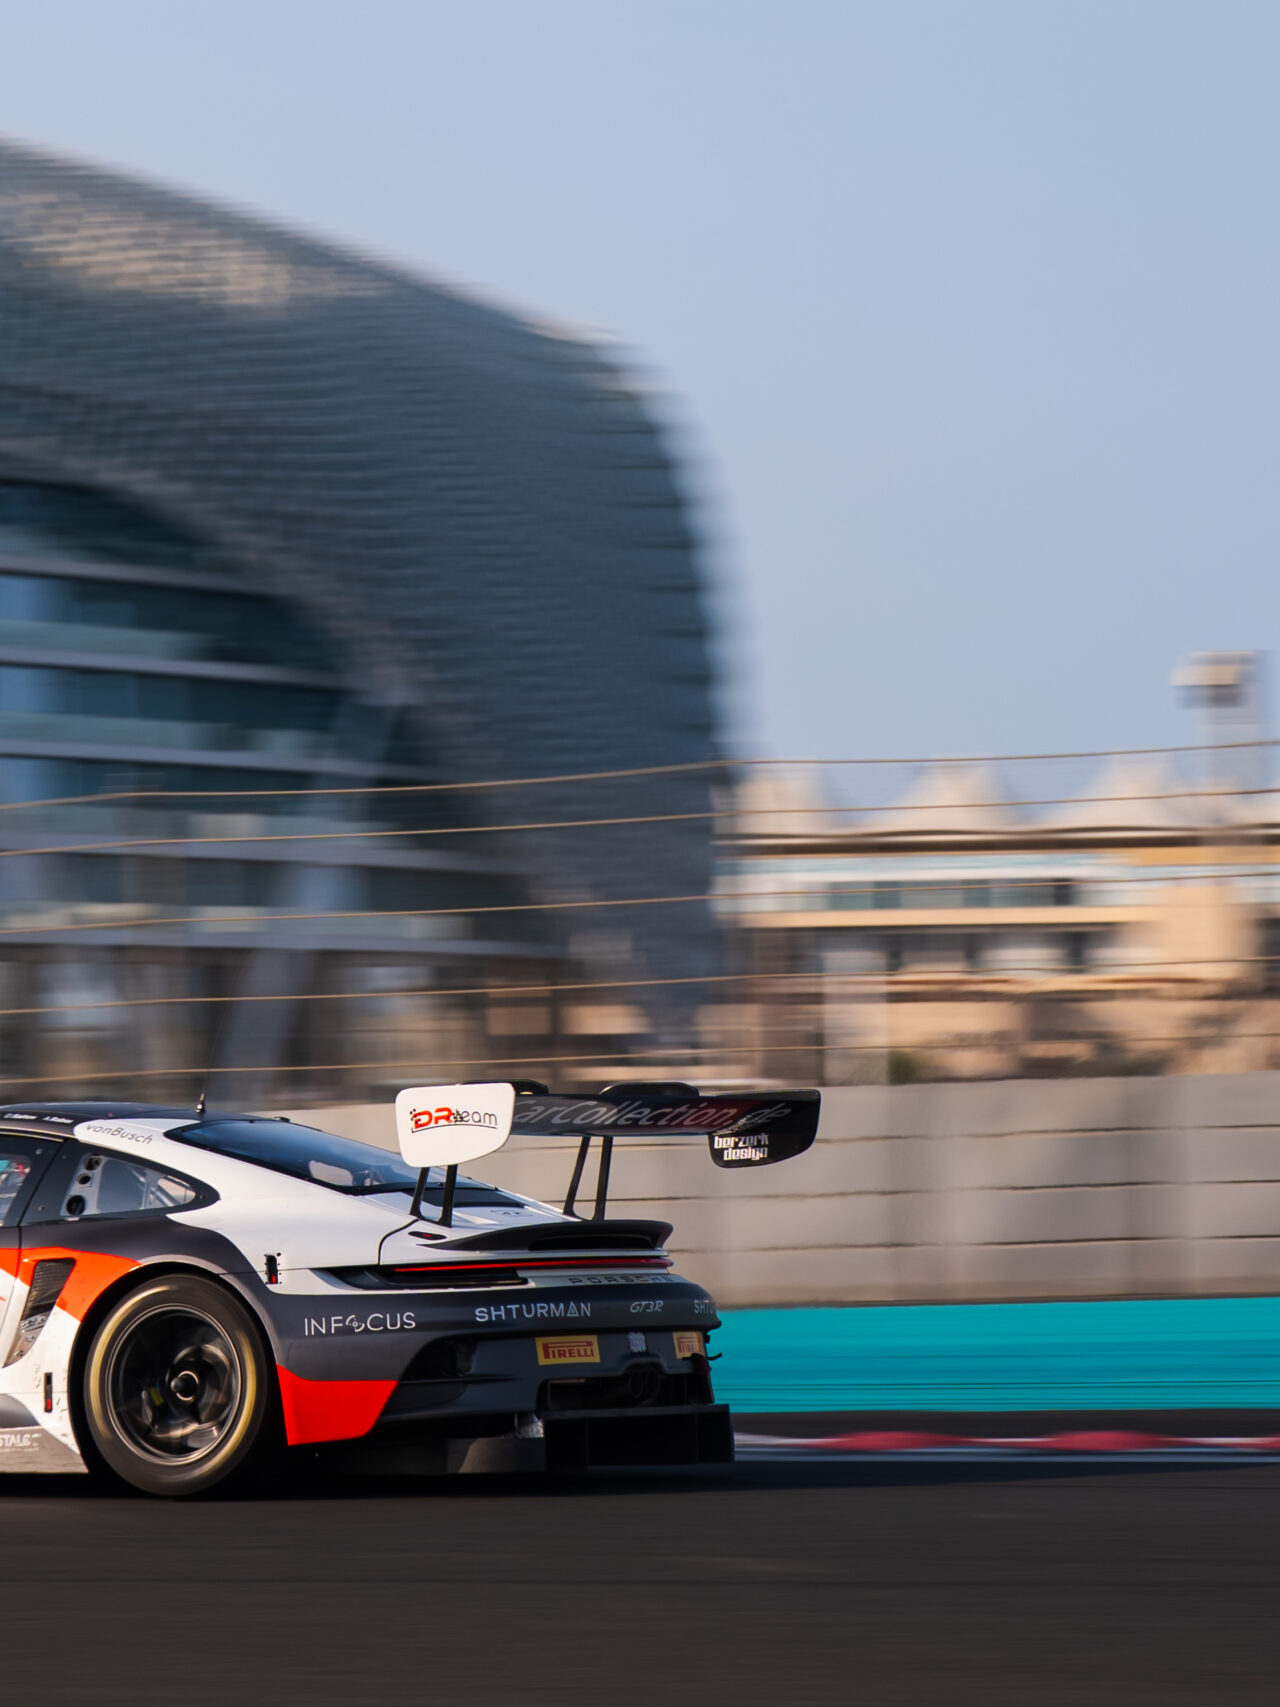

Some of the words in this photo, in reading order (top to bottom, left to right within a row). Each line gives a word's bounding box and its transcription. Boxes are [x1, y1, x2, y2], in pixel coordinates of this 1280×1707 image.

[86, 1123, 153, 1146] vonBusch
[714, 1132, 769, 1149] berzerk
[723, 1147, 768, 1161] design
[475, 1302, 591, 1322] SHTURMAN
[542, 1342, 594, 1360] PIRELLI
